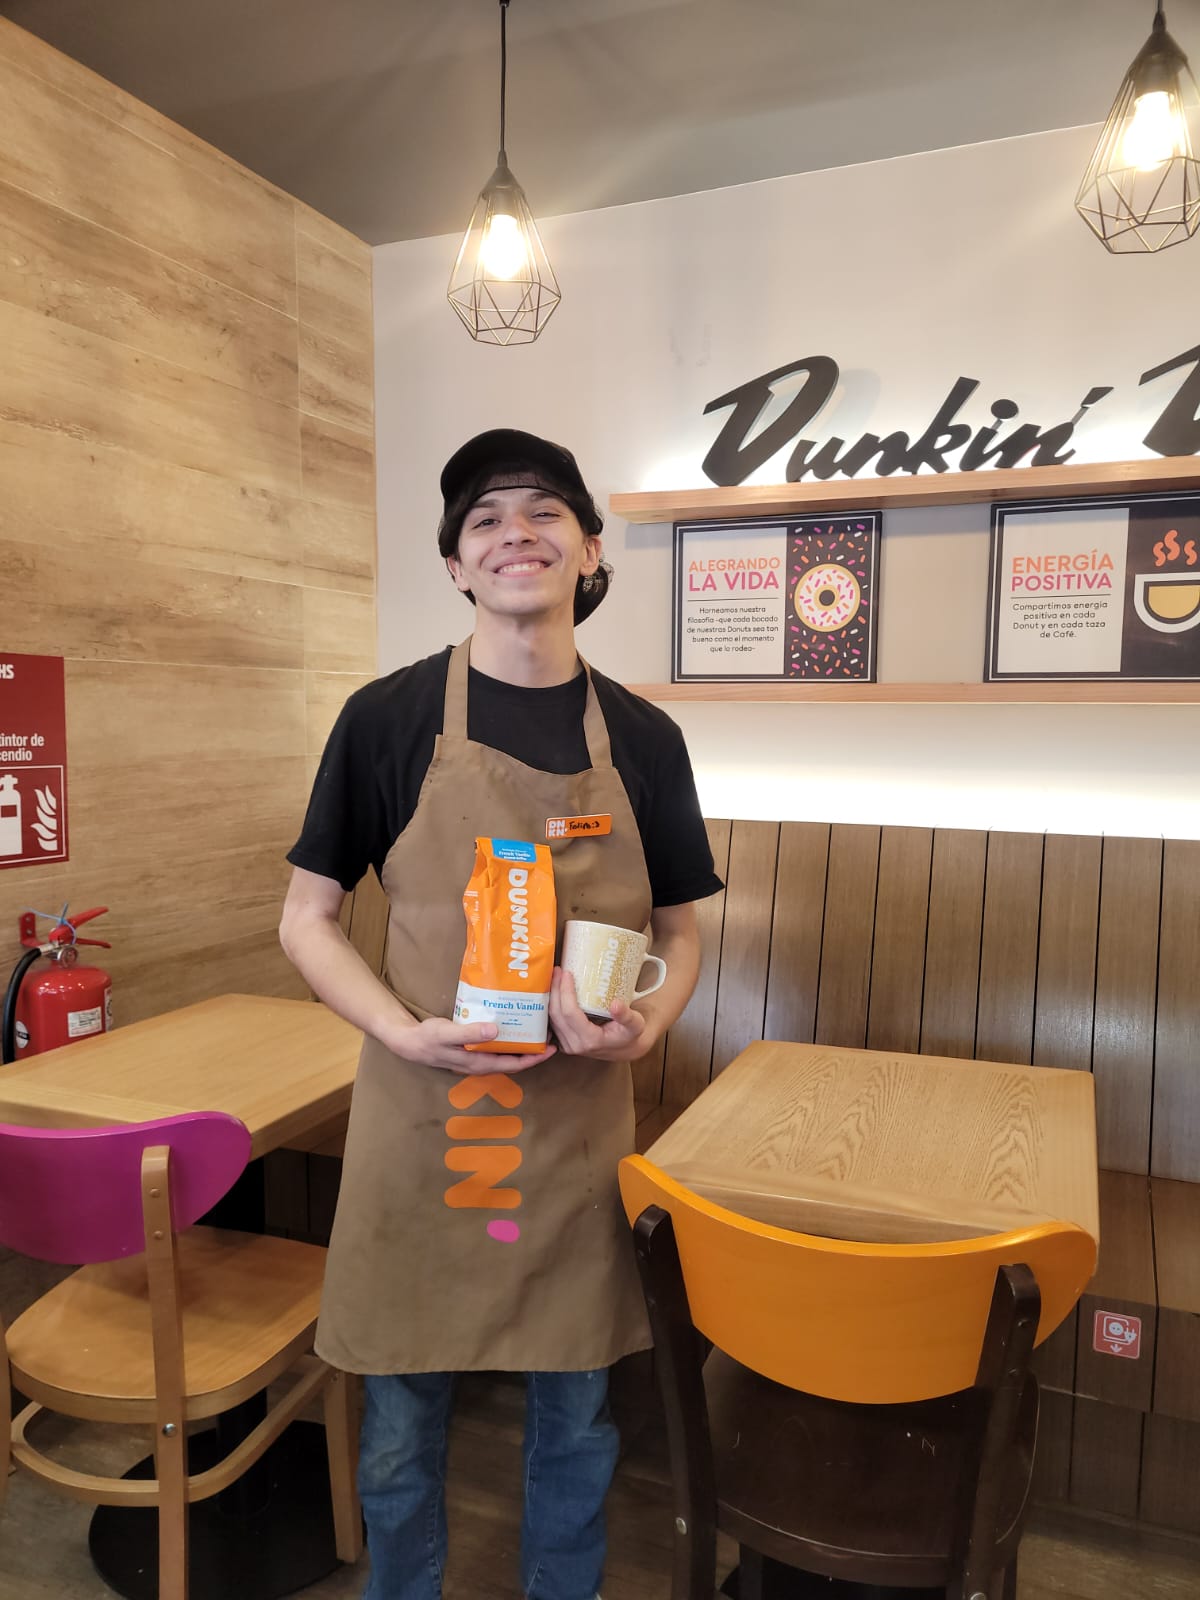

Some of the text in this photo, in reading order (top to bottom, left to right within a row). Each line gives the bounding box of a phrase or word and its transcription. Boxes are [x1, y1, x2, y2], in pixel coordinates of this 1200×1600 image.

[702, 355, 1113, 487] Dunkin'
[688, 557, 781, 572] ALEGRANDO
[1012, 548, 1114, 574] ENERGÍA
[688, 571, 779, 592] LA VIDA
[1011, 572, 1112, 592] POSITIVA
[1012, 601, 1072, 611] Compartimos
[1023, 612, 1058, 621] positiva
[1072, 611, 1096, 619] cada
[1013, 622, 1039, 630] Donut
[1060, 621, 1084, 629] cada
[1052, 630, 1077, 638] Café.
[30, 733, 45, 747] de
[508, 868, 531, 979] DUNKIN'
[483, 999, 514, 1009] French
[516, 1002, 545, 1011] Vanilla
